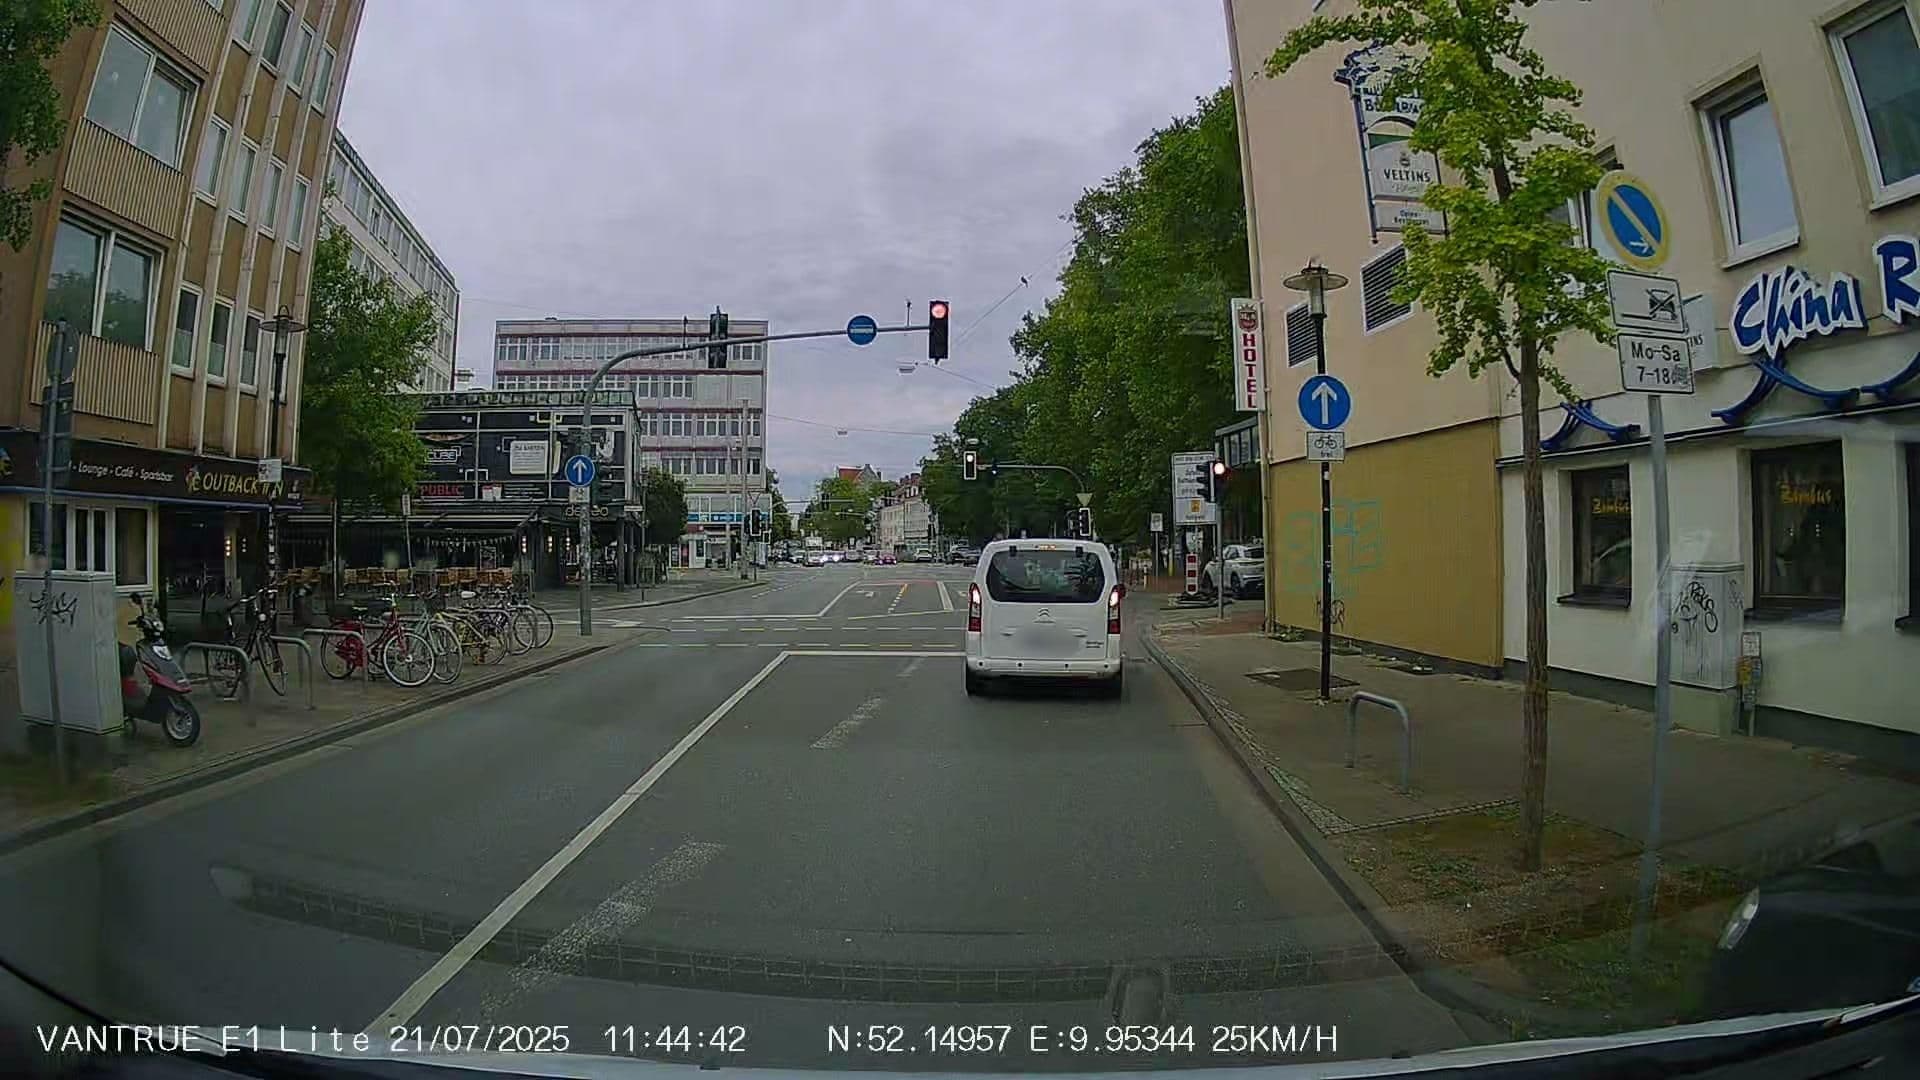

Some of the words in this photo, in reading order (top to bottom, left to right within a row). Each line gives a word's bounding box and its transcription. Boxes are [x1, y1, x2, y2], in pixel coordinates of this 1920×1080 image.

[1384, 168, 1431, 182] VELTINS
[1731, 266, 1868, 358] China
[1631, 341, 1681, 361] Mo-Sa
[1243, 333, 1257, 408] HOTEL
[79, 461, 108, 477] Lounge
[115, 466, 134, 478] Café
[203, 472, 258, 494] OUTBACK
[421, 484, 464, 496] PUBLIC
